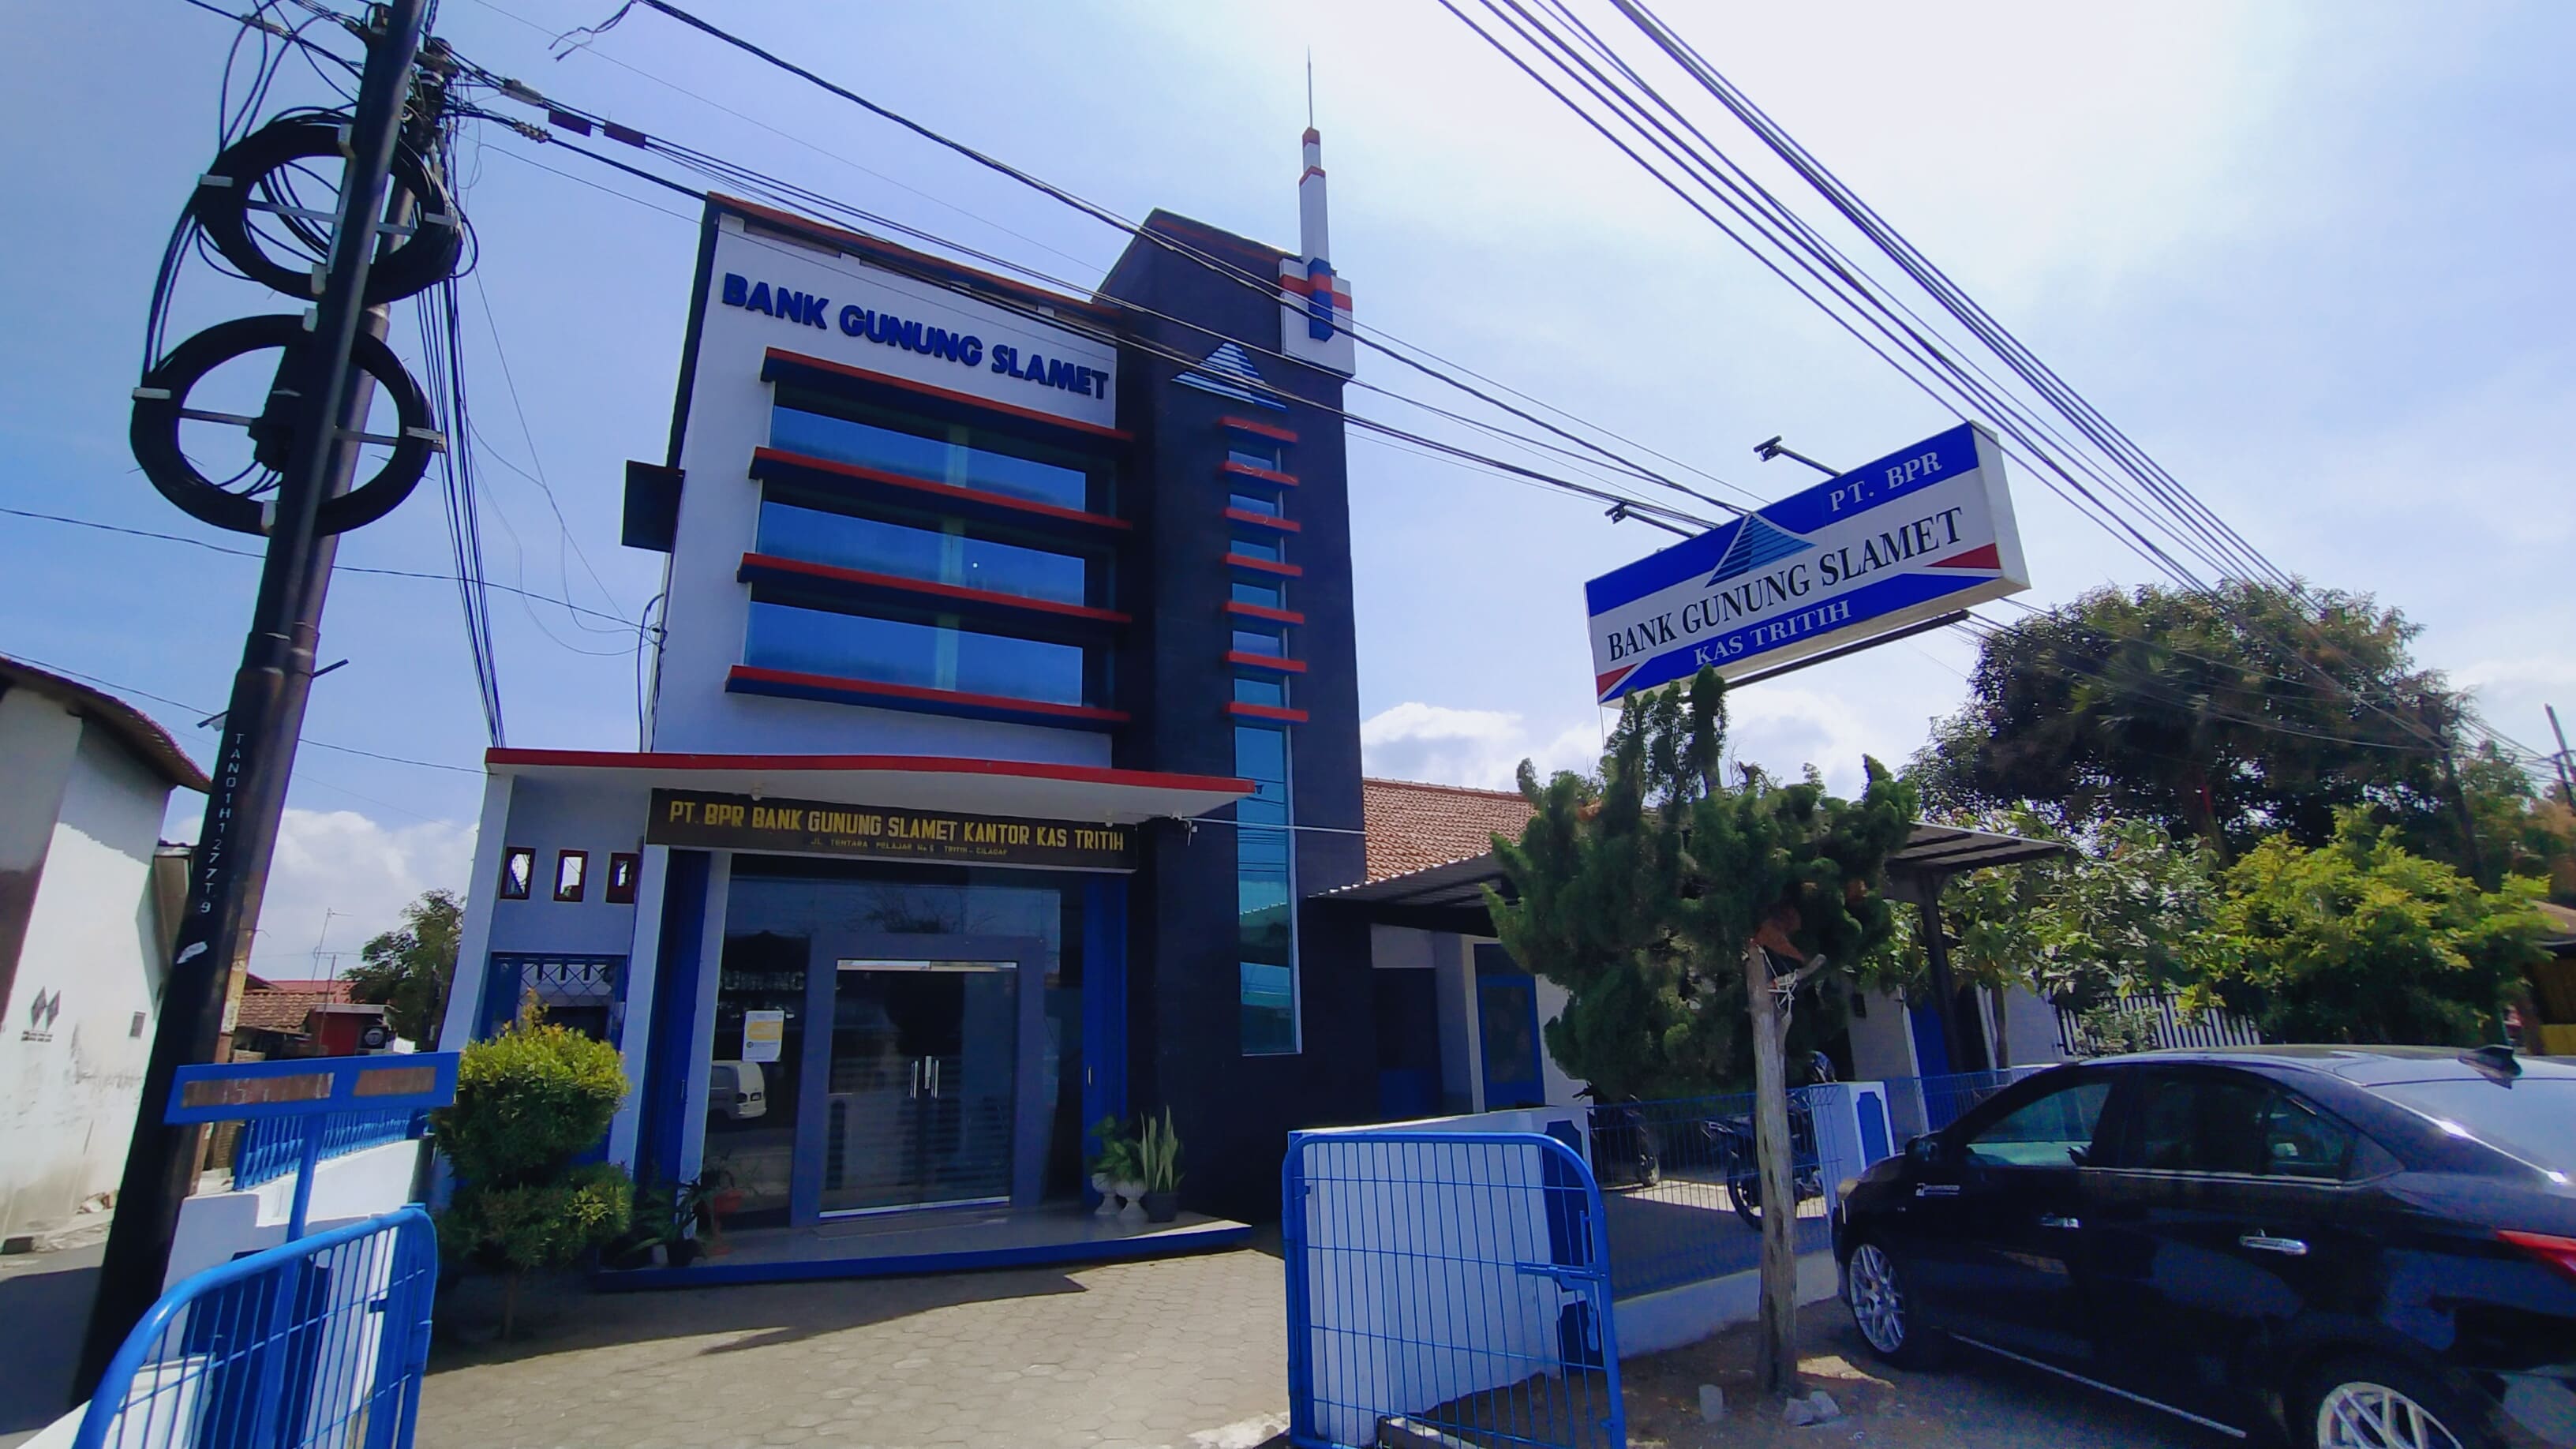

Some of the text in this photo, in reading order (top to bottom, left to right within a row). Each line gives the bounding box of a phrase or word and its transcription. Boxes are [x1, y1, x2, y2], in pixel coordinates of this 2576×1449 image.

[722, 272, 1109, 400] BANK GUNUNG SLAMET
[1829, 451, 1943, 513] PT. BPR
[1607, 507, 1963, 663] BANK GUNUNG SLAMET
[1693, 600, 1852, 667] KAS TRITIH
[669, 800, 1125, 852] PT. BPR BANK GUNUNG SLAMET KANTOR KAS TRITIH
[829, 839, 868, 848] TENTARA
[875, 841, 912, 850] PELAJAR
